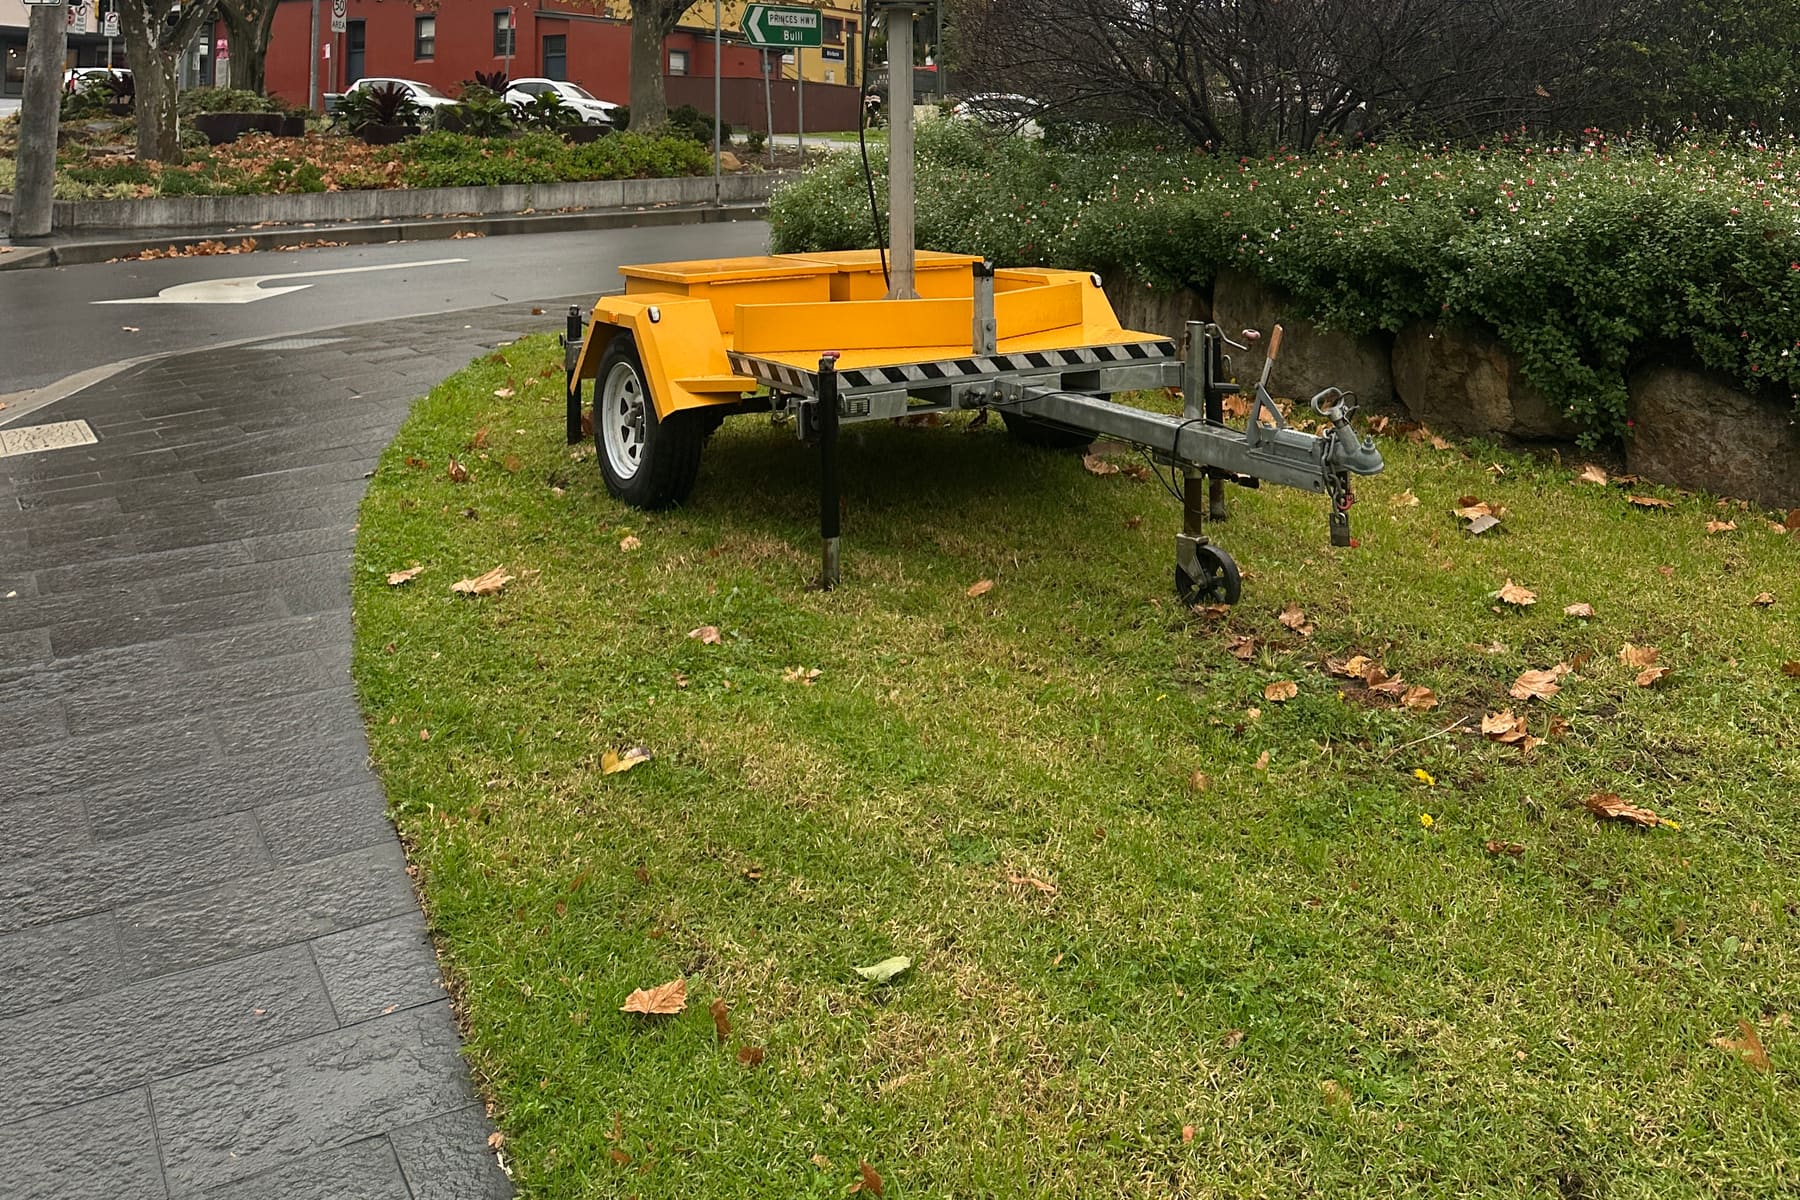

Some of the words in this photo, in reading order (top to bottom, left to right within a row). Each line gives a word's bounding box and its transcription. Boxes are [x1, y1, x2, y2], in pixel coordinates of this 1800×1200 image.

[335, 0, 344, 11] 50
[332, 20, 345, 28] AREA
[769, 13, 798, 25] PRINCES
[800, 15, 815, 25] HWY
[783, 29, 803, 41] Bulli
